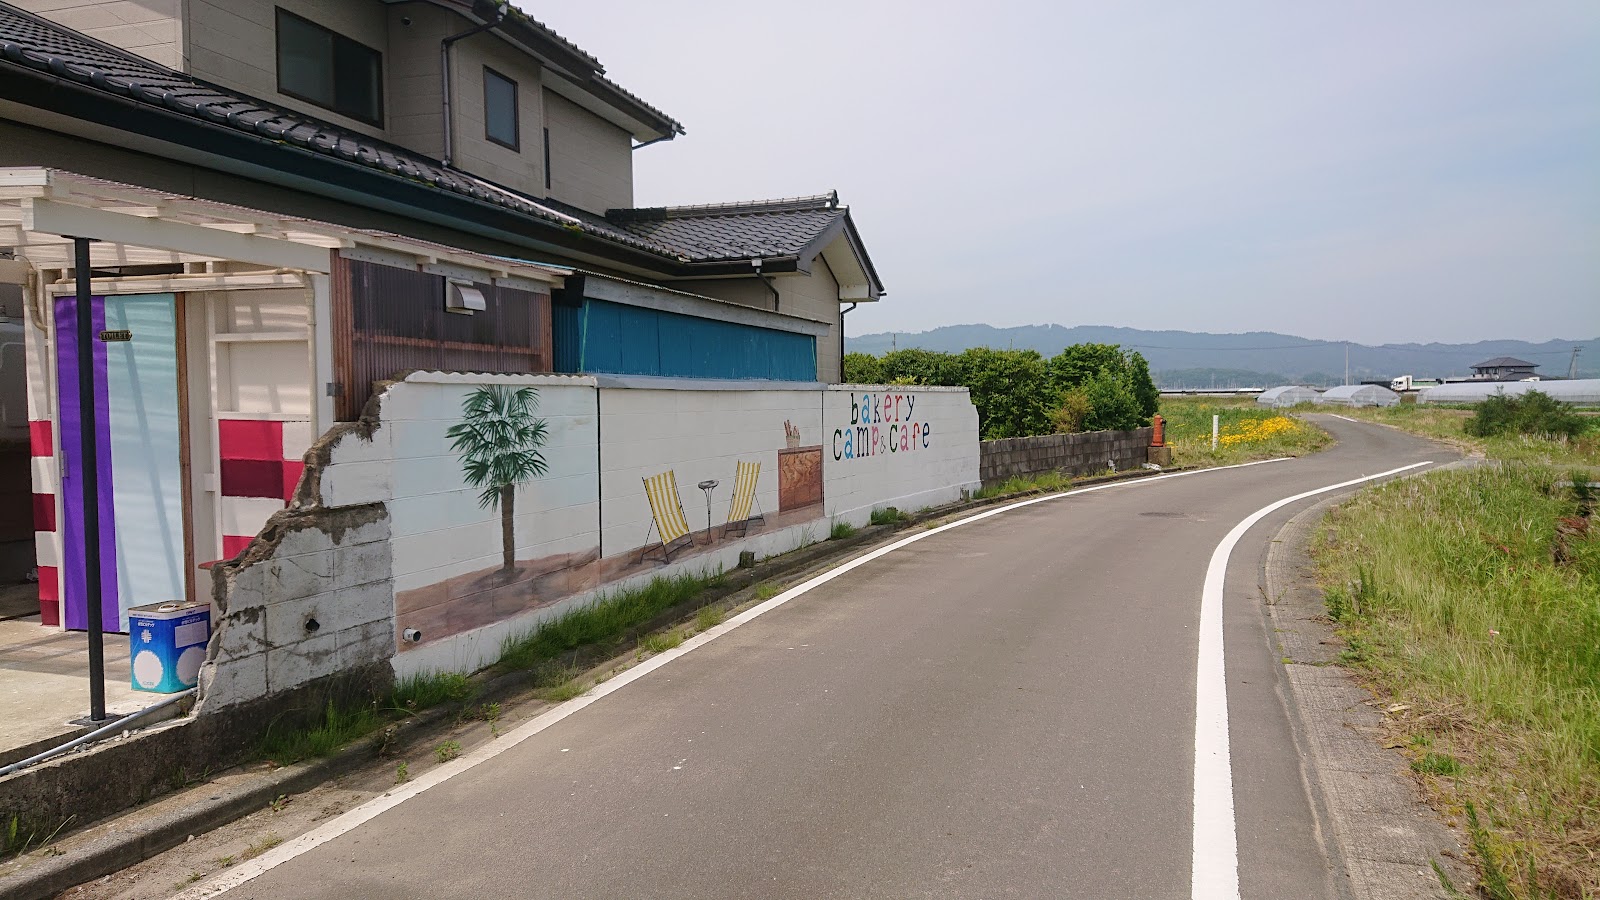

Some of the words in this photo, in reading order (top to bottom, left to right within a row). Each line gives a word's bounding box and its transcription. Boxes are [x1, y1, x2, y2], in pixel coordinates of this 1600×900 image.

[103, 332, 128, 340] TOILET
[850, 393, 915, 425] bakery
[833, 426, 880, 461] camp
[889, 422, 930, 453] cafe
